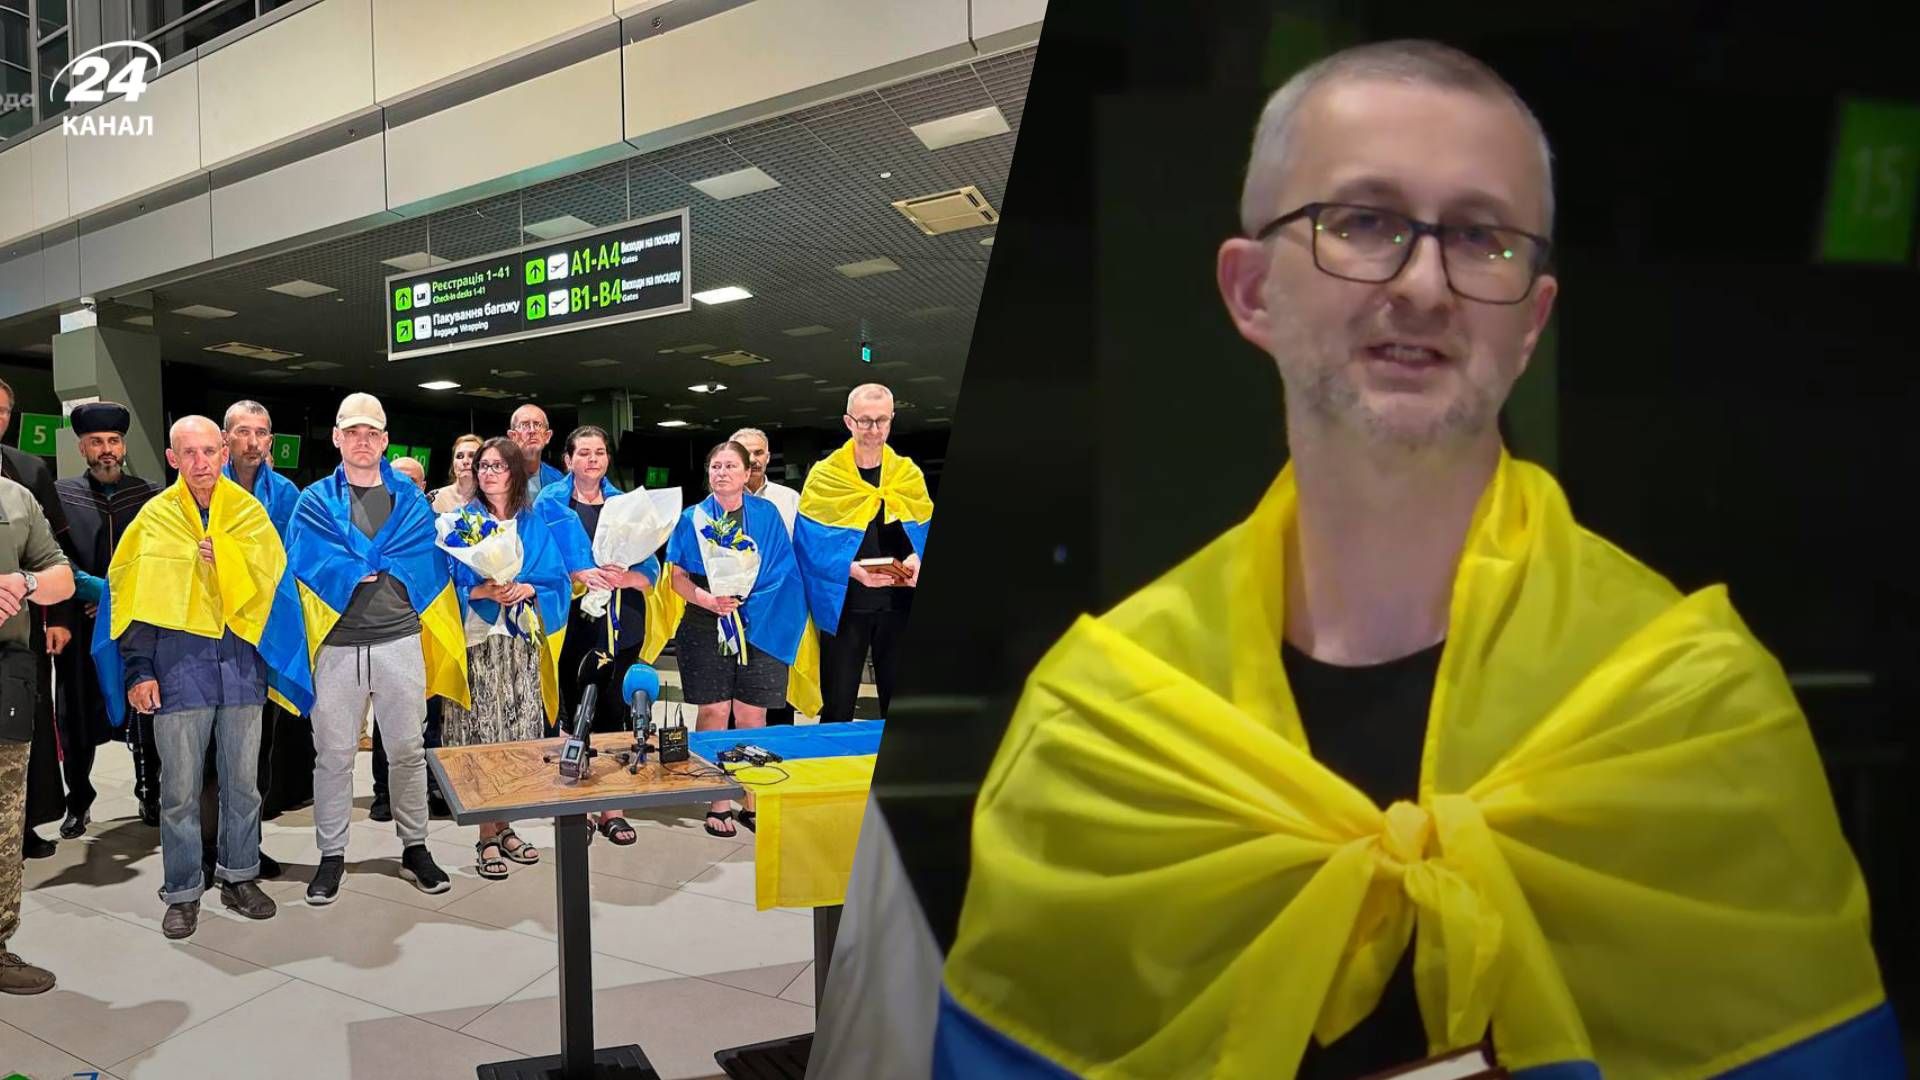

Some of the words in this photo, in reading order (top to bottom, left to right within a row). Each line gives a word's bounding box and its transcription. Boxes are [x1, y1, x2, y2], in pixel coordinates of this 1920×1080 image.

[1855, 145, 1906, 215] 15
[645, 237, 653, 248] на
[654, 232, 681, 246] посадку
[571, 241, 620, 276] A1-A4
[621, 255, 638, 265] Gates
[432, 272, 484, 292] Реєстрація
[486, 265, 510, 281] 1-41
[645, 276, 654, 286] на
[654, 271, 681, 285] посадку
[456, 289, 473, 299] desks
[571, 279, 622, 312] B1-B4
[622, 293, 639, 302] Gates
[433, 307, 483, 326] Пакування
[484, 300, 520, 316] багажу
[33, 425, 47, 445] 5
[281, 443, 290, 459] 8
